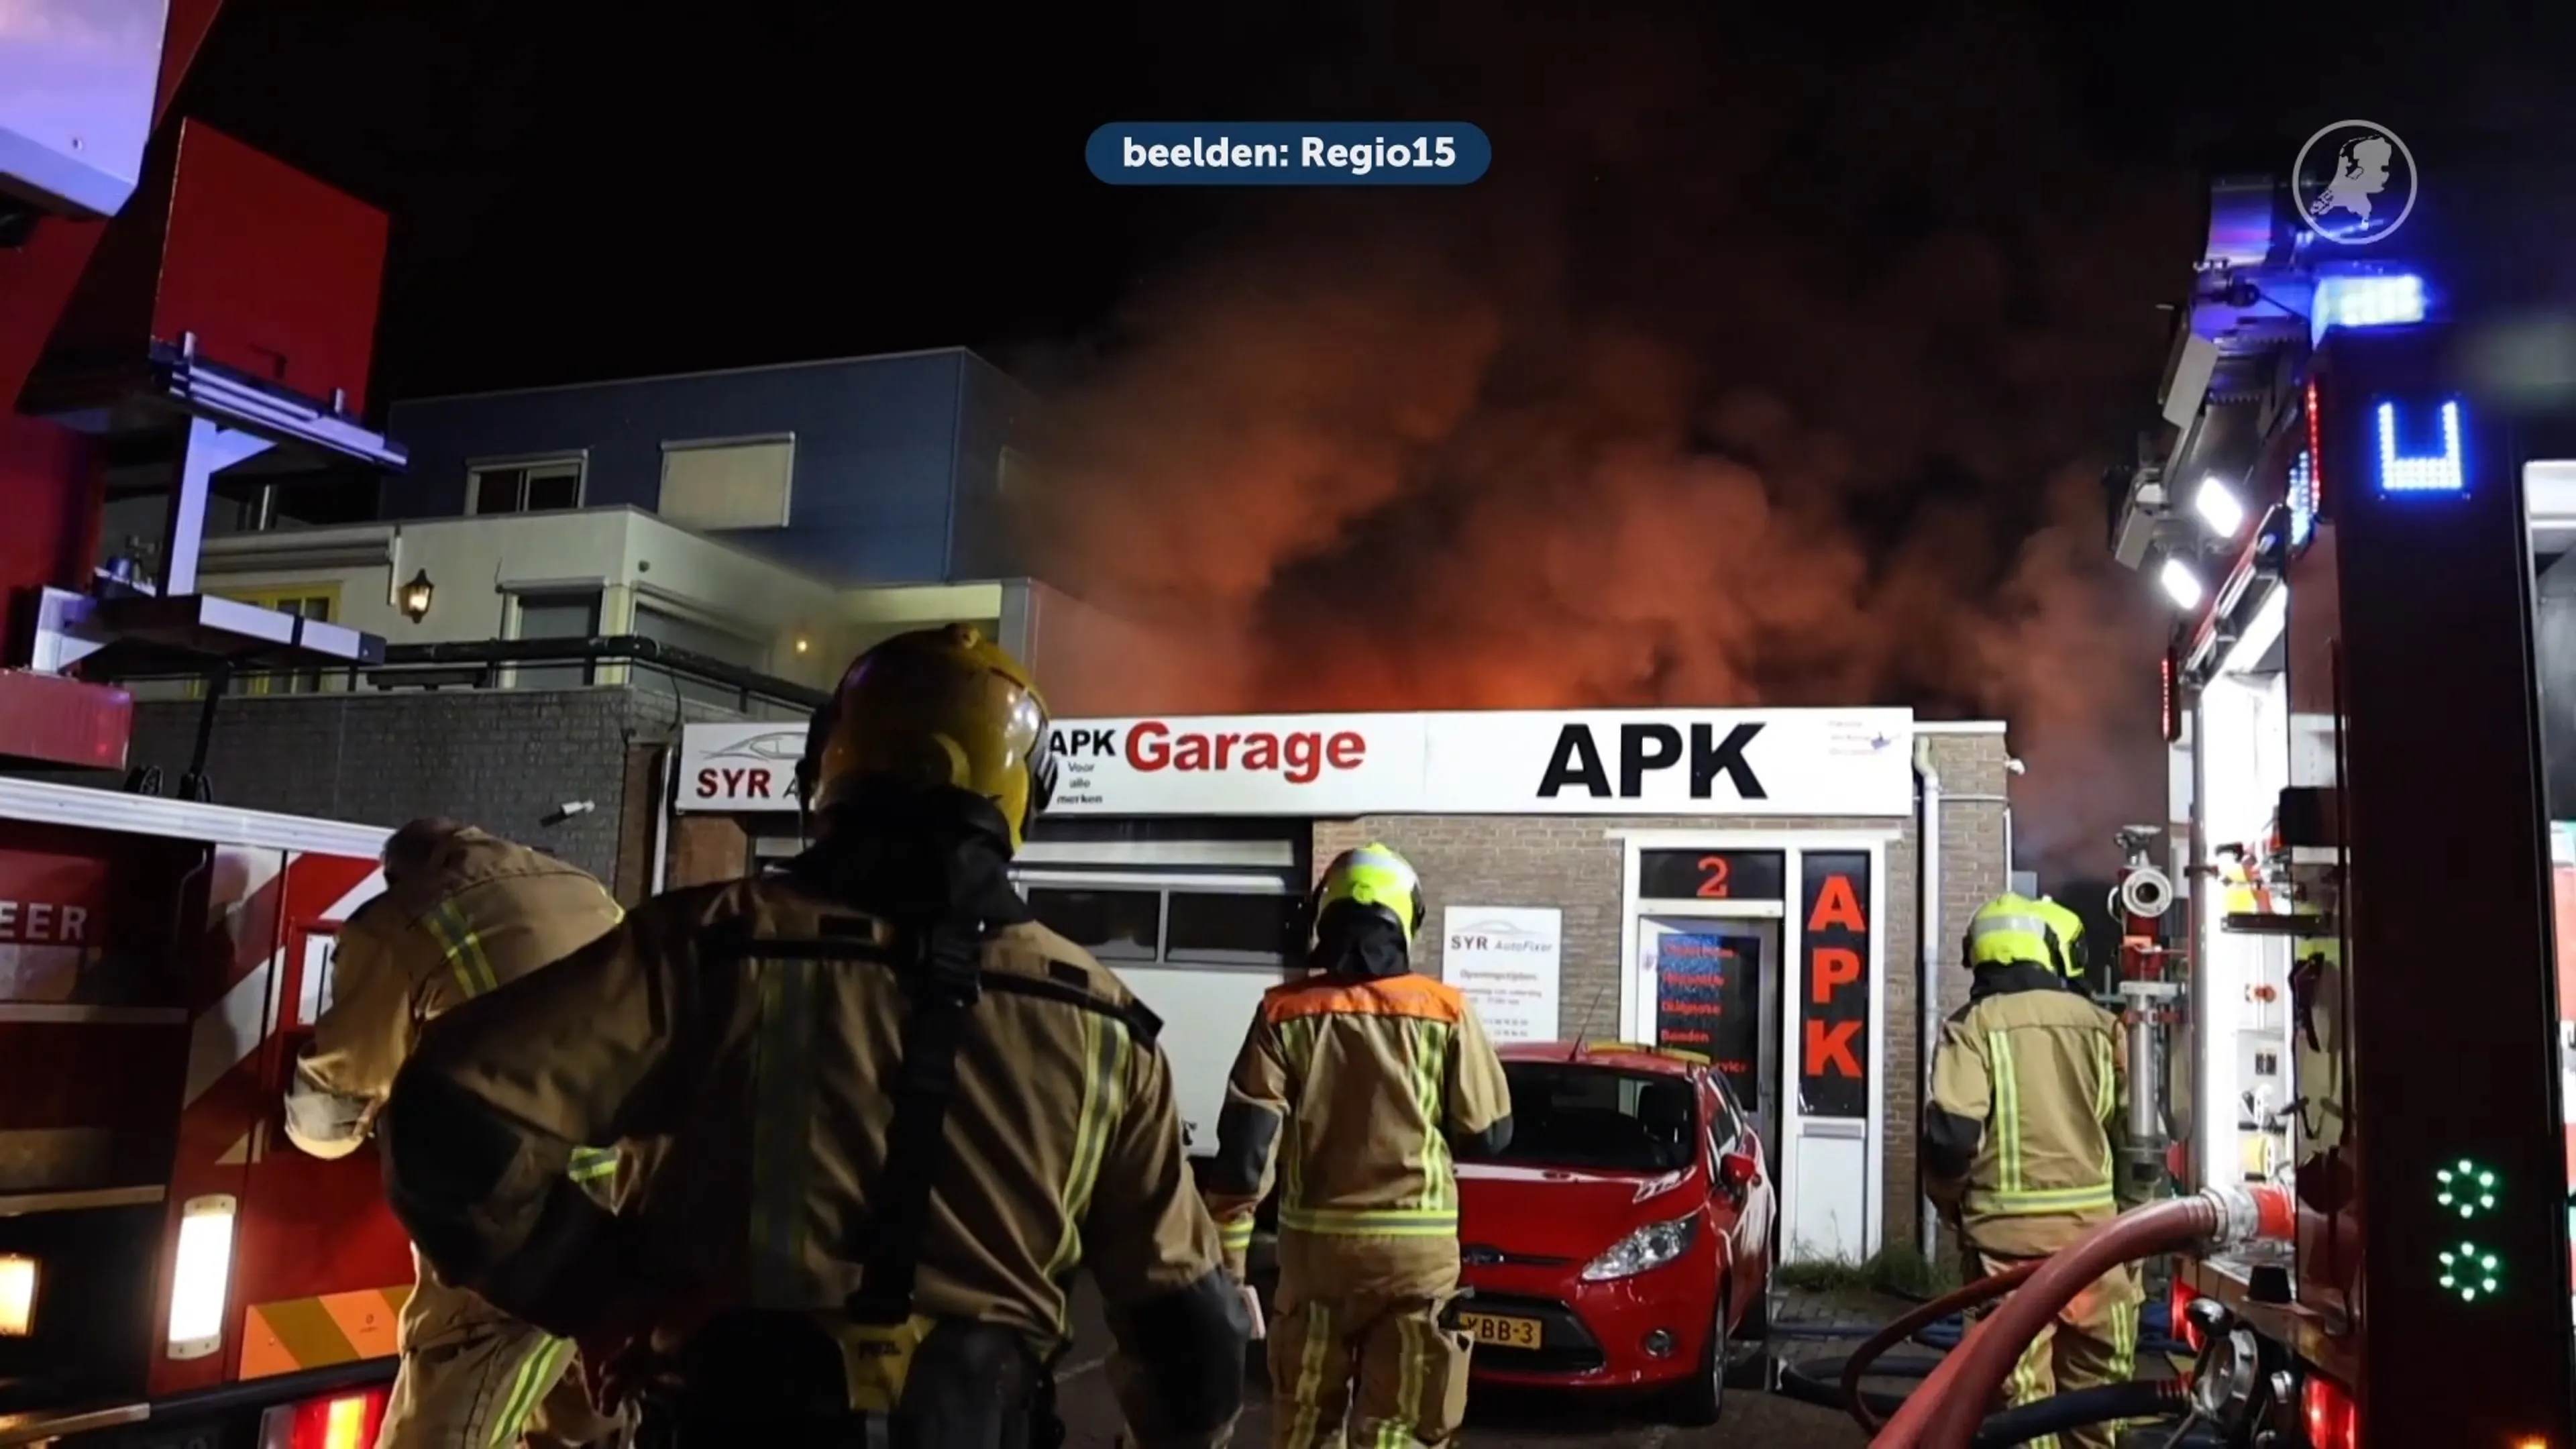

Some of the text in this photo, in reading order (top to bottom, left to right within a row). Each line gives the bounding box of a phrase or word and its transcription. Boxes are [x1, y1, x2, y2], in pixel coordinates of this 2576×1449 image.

[1049, 720, 1366, 784] APK Garage
[1068, 761, 1095, 772] Voor
[1536, 722, 1768, 800] APK
[696, 767, 771, 799] SYR
[1069, 777, 1091, 788] alle
[1057, 794, 1103, 804] merken
[1696, 856, 1729, 898] 2
[0, 900, 87, 941] EER
[1450, 935, 1488, 951] SYR
[1807, 875, 1867, 1078] APK
[1661, 1028, 1709, 1043] Banden
